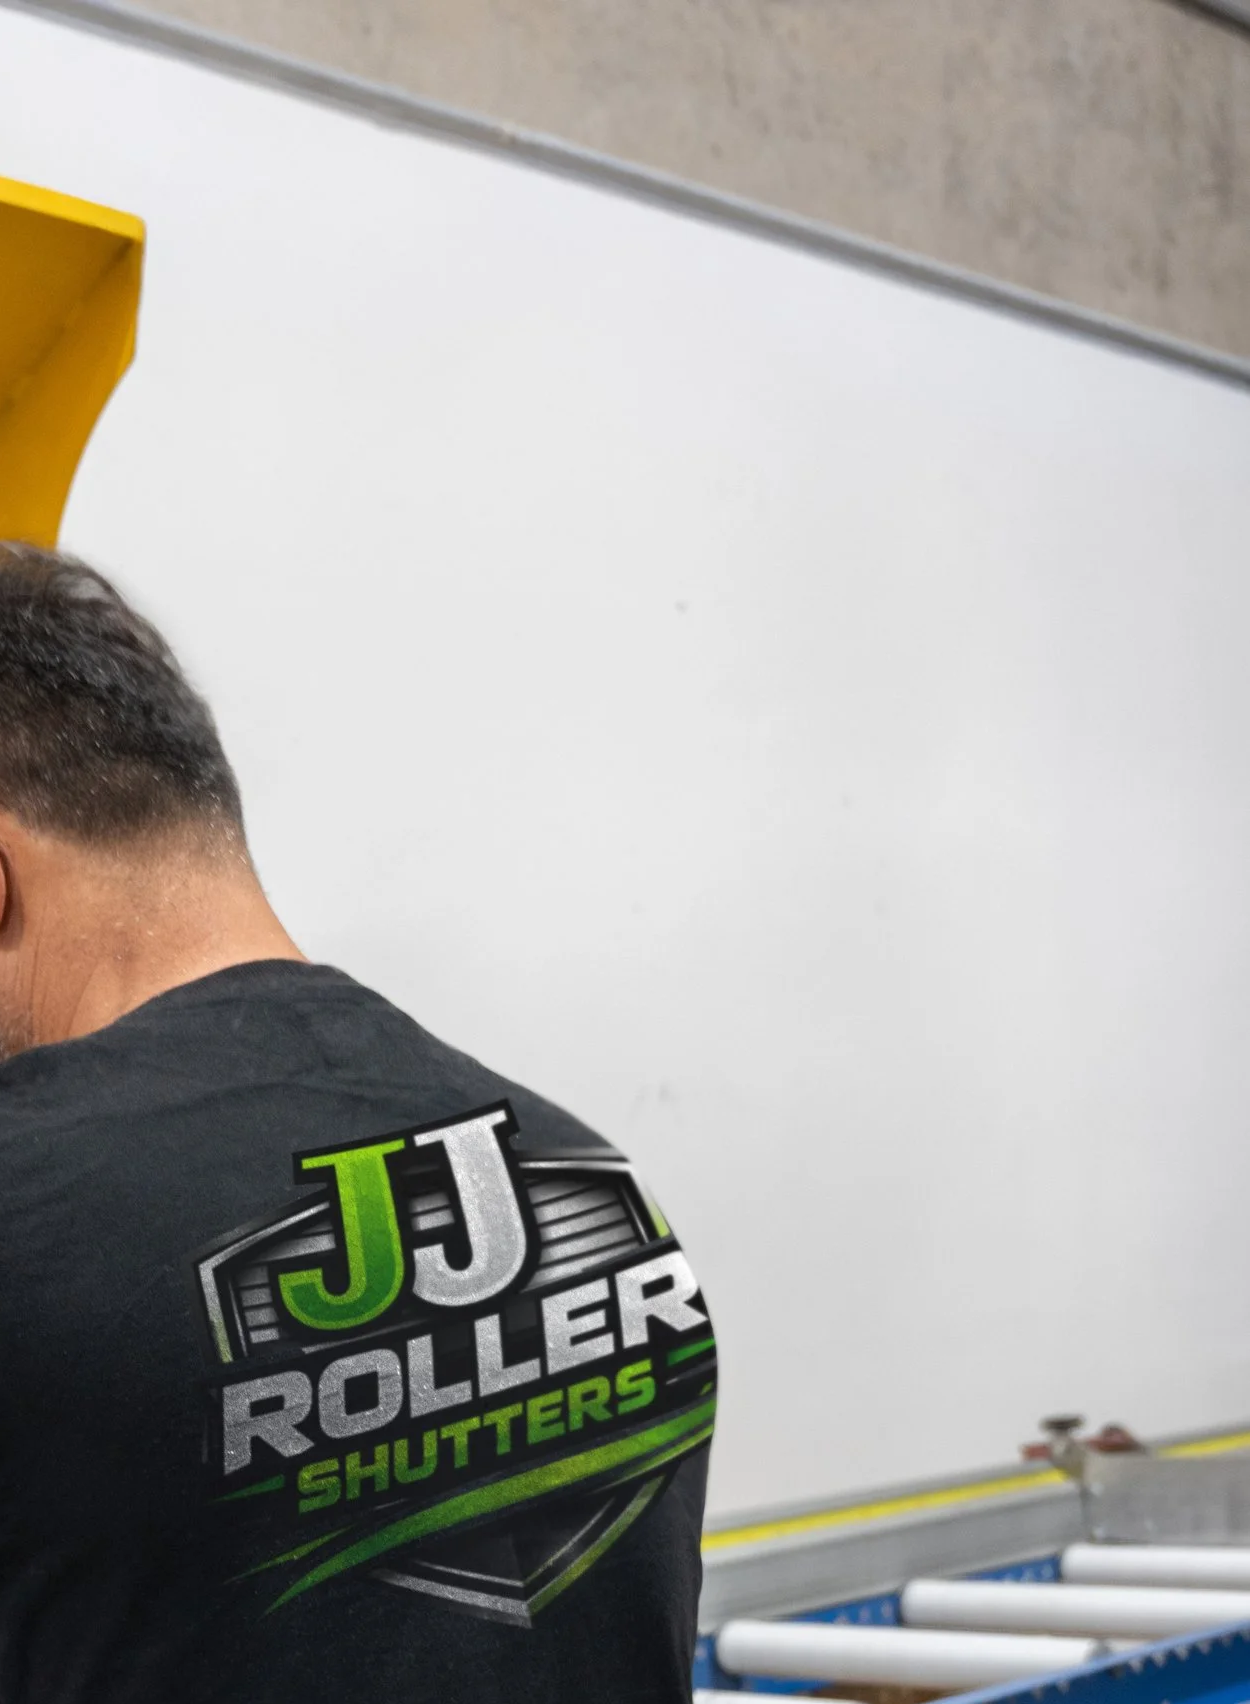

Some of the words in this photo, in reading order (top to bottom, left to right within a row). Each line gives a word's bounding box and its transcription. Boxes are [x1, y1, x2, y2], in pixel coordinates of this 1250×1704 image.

[277, 1109, 527, 1330] JJ
[223, 1250, 709, 1475] ROLLER
[297, 1360, 657, 1513] SHUTTERS
